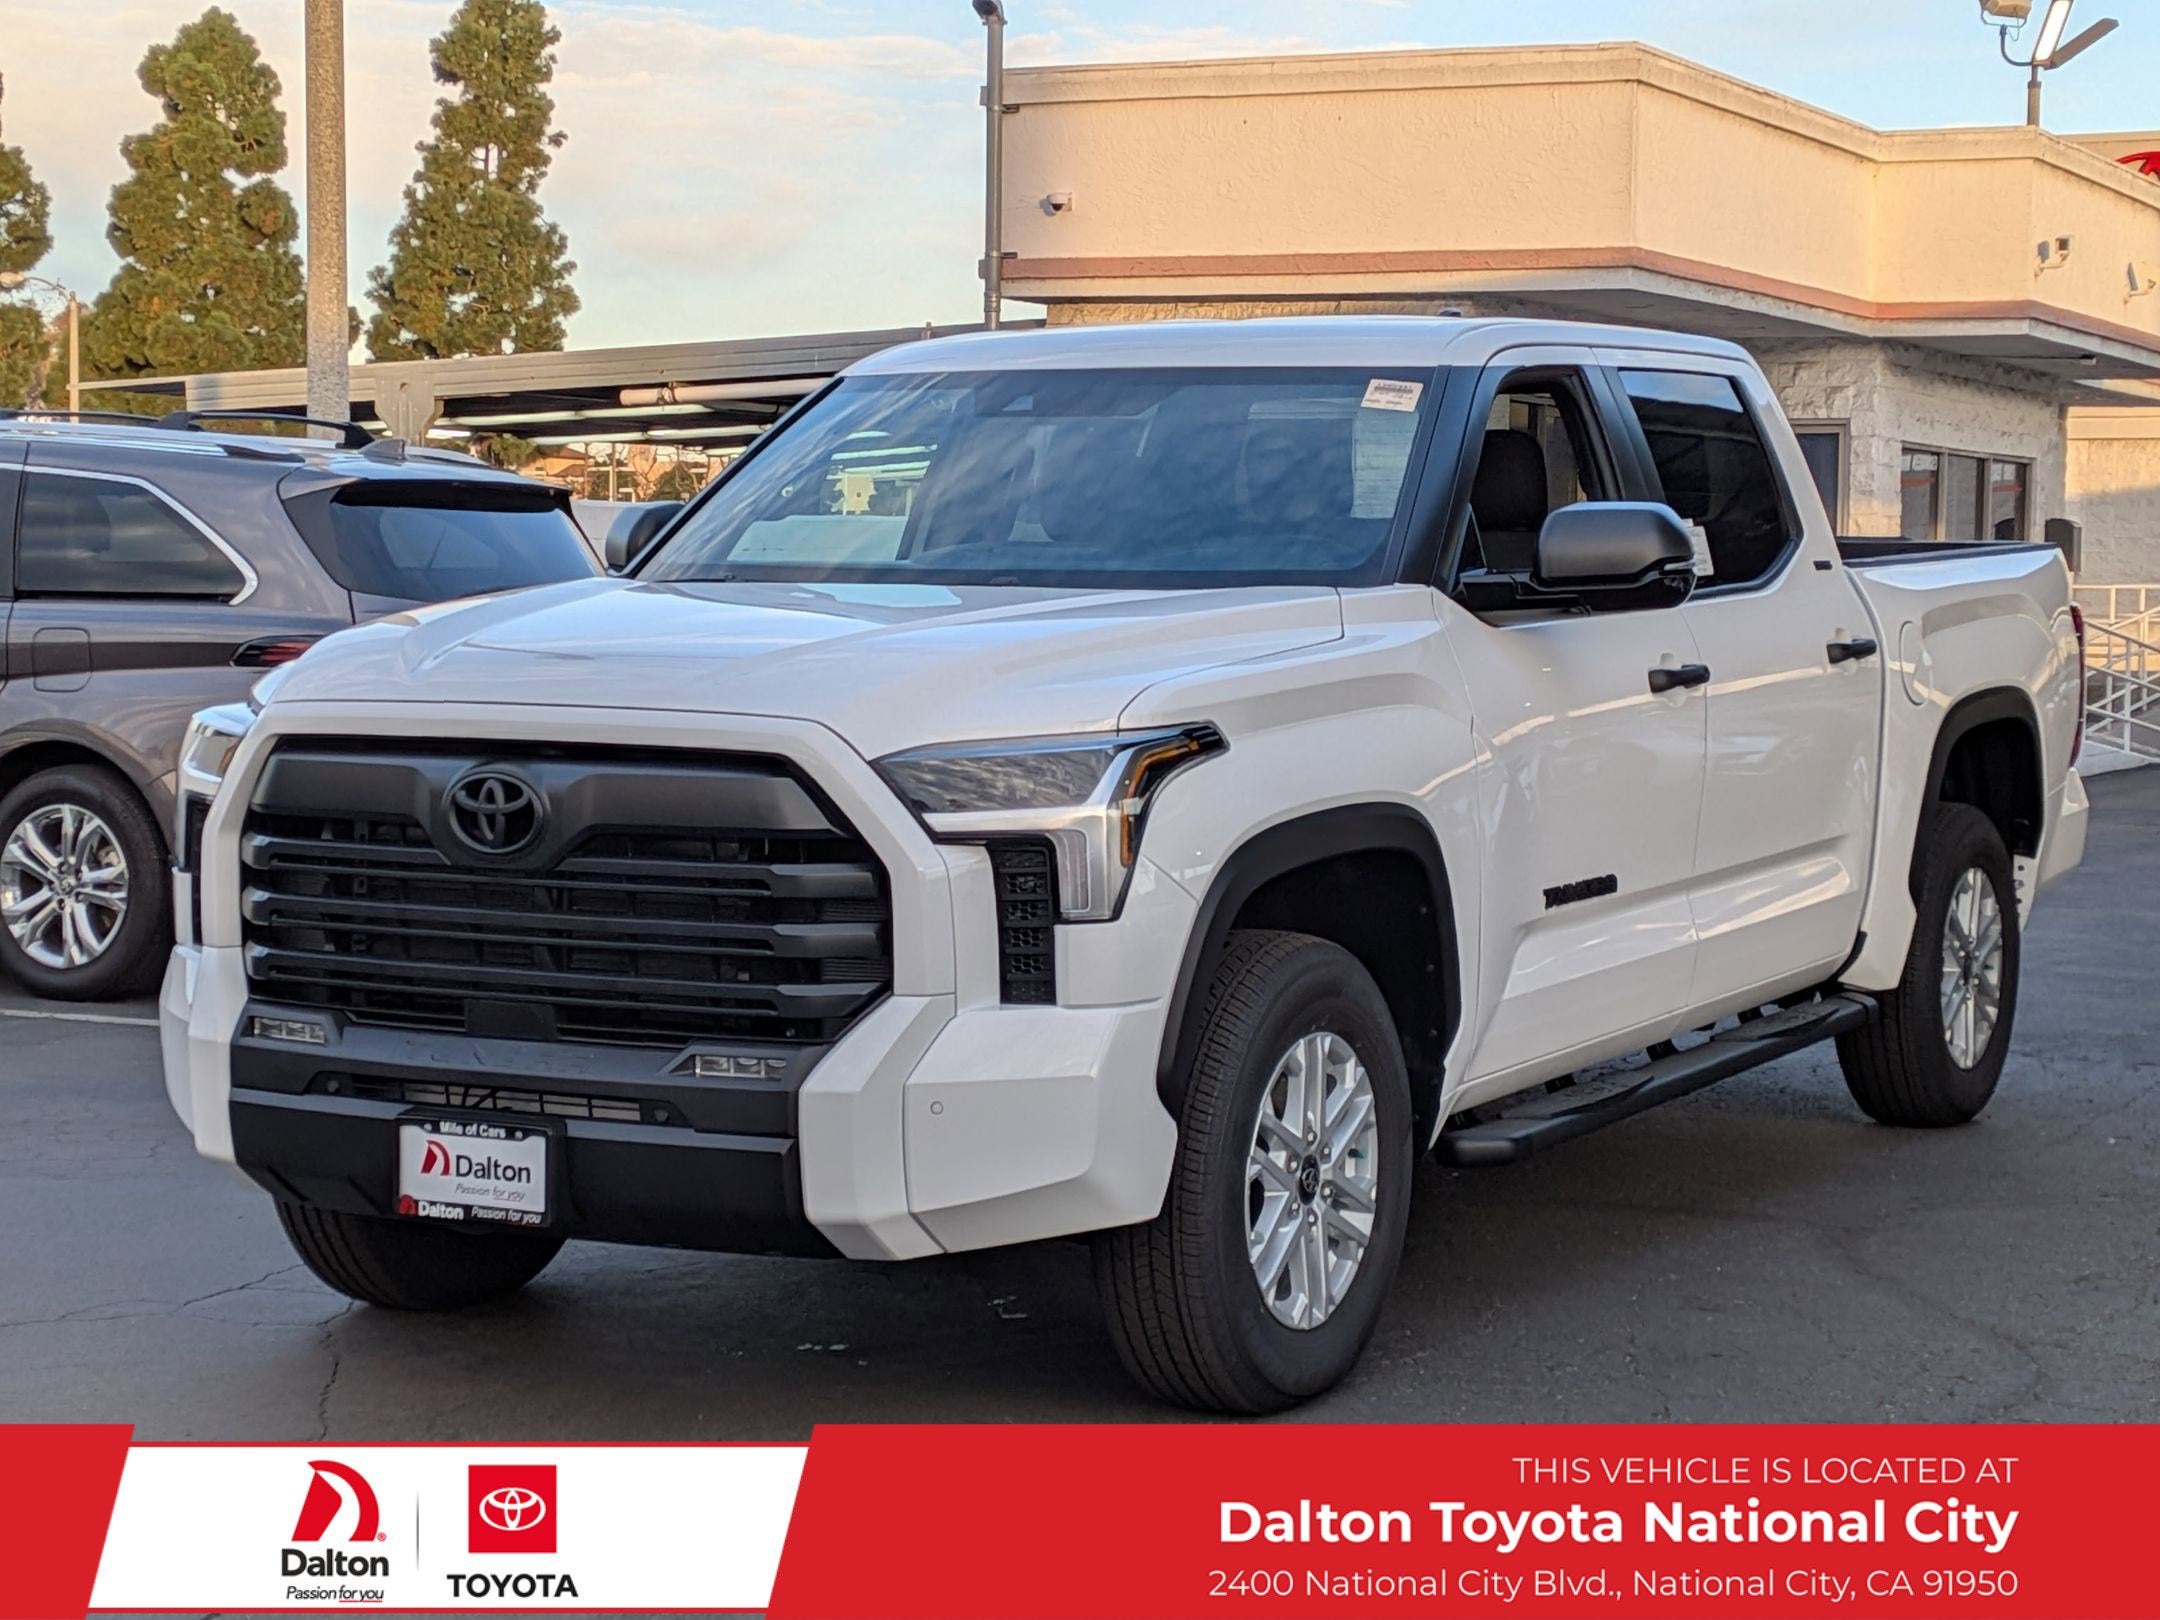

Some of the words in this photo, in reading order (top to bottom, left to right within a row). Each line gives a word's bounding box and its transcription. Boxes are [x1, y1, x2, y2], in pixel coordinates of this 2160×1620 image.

[439, 1121, 463, 1134] Mile
[465, 1123, 478, 1135] of
[479, 1124, 506, 1138] Cars
[455, 1154, 531, 1184] Dalton
[455, 1184, 490, 1197] Passion
[492, 1186, 506, 1200] for
[507, 1190, 527, 1202] you
[418, 1201, 465, 1220] Dalton
[471, 1206, 506, 1220] Passion
[507, 1209, 522, 1222] for
[523, 1212, 542, 1225] you
